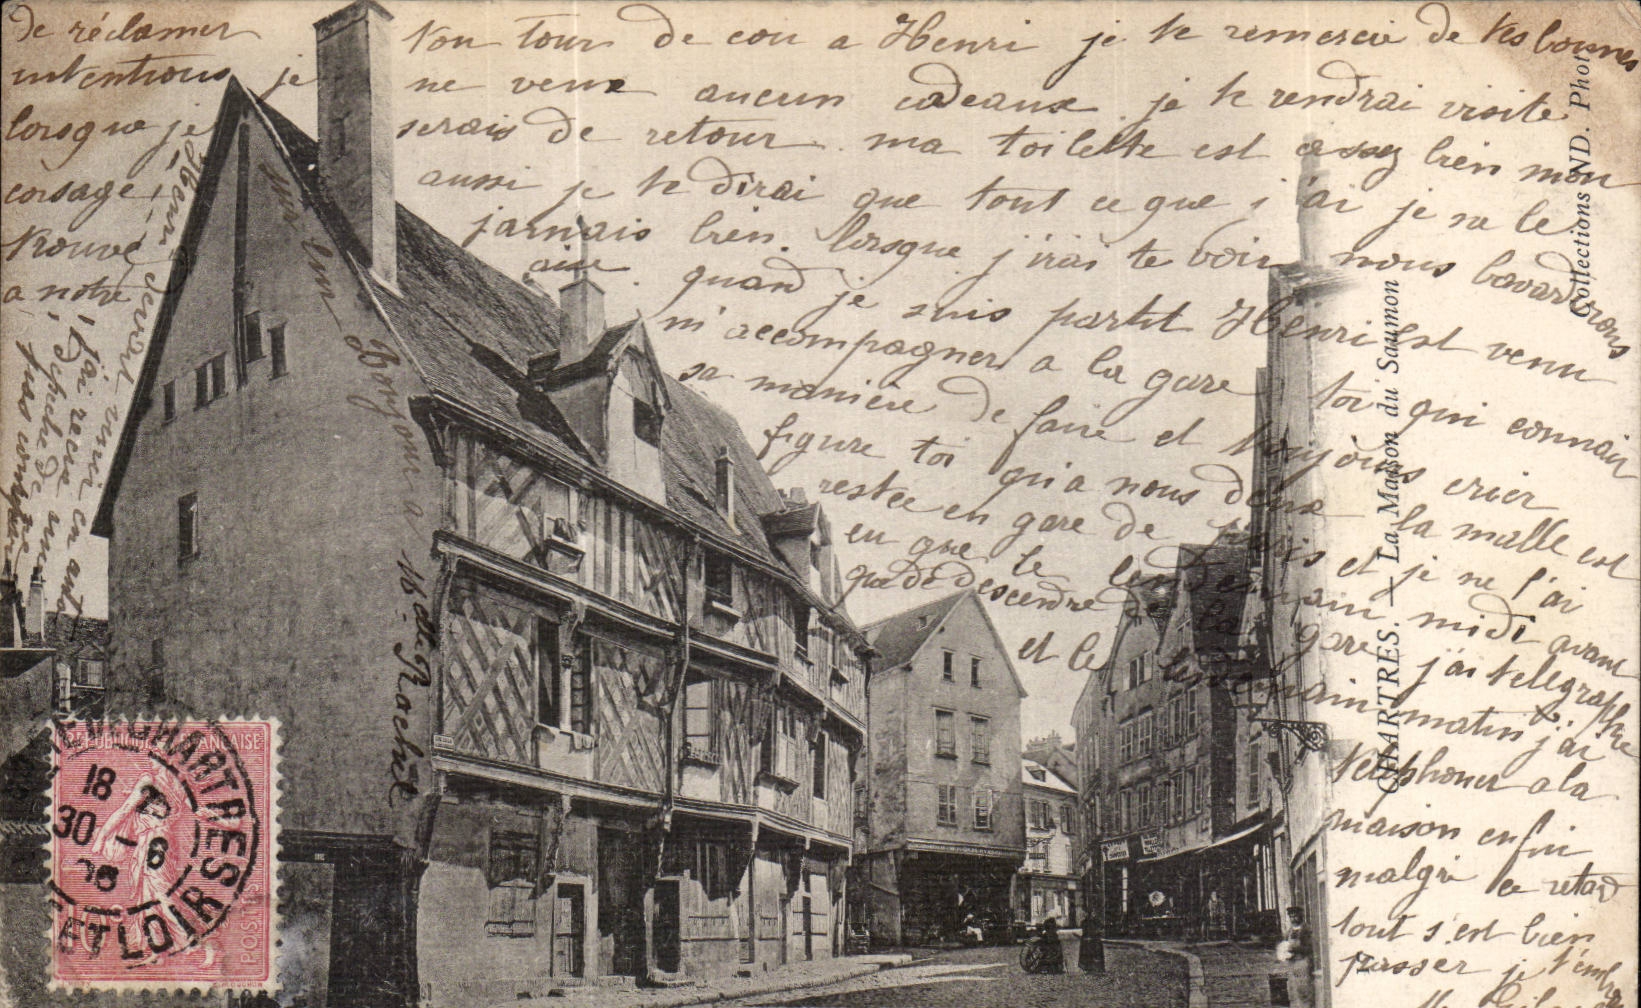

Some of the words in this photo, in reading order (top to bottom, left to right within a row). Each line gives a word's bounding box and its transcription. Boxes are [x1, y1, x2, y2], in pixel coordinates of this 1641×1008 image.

[878, 11, 1038, 55] Henri
[1271, 60, 1420, 112] rendrai
[1439, 83, 1570, 123] visite
[5, 104, 153, 171] lorsque
[1424, 135, 1502, 176] bien
[1518, 162, 1638, 190] mon
[4, 180, 163, 232] corsage
[1515, 199, 1580, 235] le
[159, 138, 205, 260] Henri
[462, 205, 652, 246] jamais
[828, 213, 961, 290] lorsque
[1187, 219, 1275, 270] voir
[652, 256, 825, 318] quand
[902, 298, 1012, 324] suis
[1211, 297, 1378, 348] Henri
[1486, 340, 1616, 385] venu
[345, 334, 421, 490] Bonjour
[1100, 368, 1270, 427] gare
[756, 412, 886, 475] figure
[911, 435, 970, 467] toi
[1104, 476, 1200, 506] nous
[1391, 504, 1441, 538] la
[1452, 517, 1569, 557] malle
[989, 395, 1136, 474] faire
[1154, 417, 1204, 447] et
[1443, 471, 1559, 510] crier
[908, 535, 988, 563] que
[943, 502, 989, 525] en
[990, 511, 1095, 558] gare
[1101, 502, 1173, 541] de
[1337, 546, 1382, 577] et
[1369, 554, 1440, 601] je
[1018, 632, 1059, 663] et
[1068, 631, 1110, 671] le
[1401, 706, 1524, 742] matin
[82, 764, 116, 800] 18
[53, 805, 96, 846] 30
[1323, 803, 1461, 840] maison
[1478, 808, 1593, 894] enfin
[1332, 906, 1416, 942] tout
[1521, 911, 1596, 947] bien
